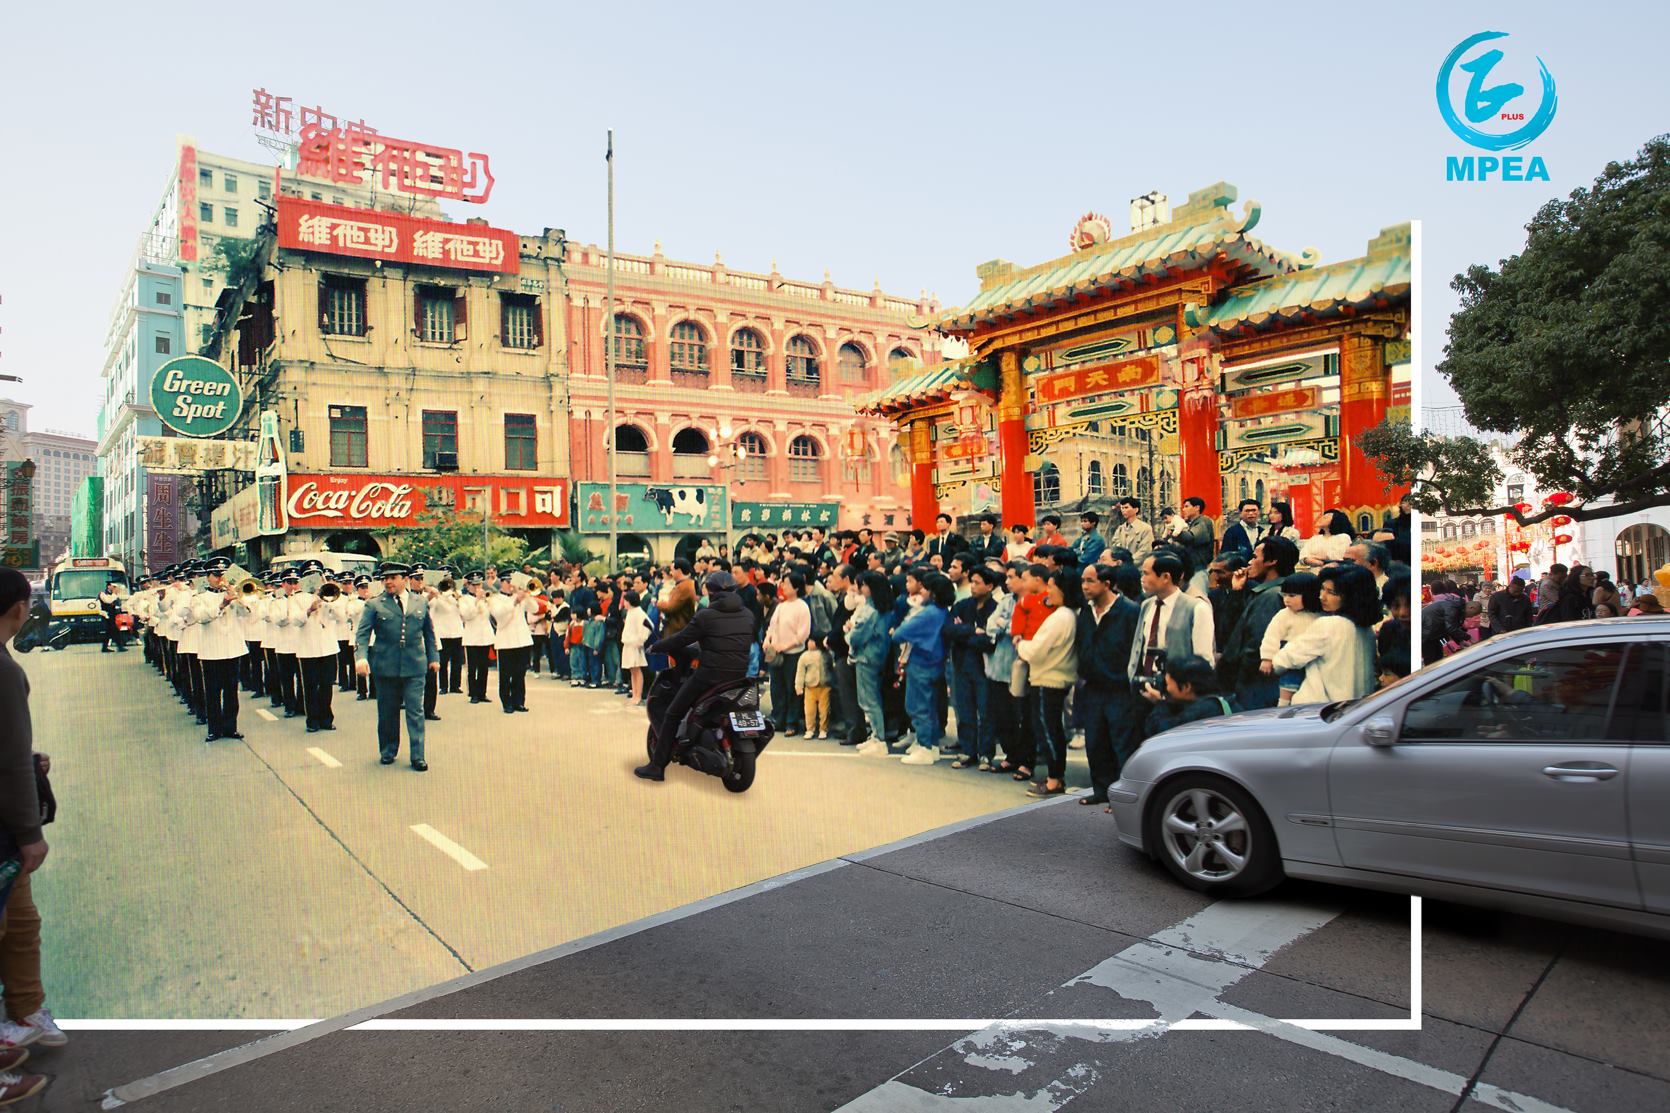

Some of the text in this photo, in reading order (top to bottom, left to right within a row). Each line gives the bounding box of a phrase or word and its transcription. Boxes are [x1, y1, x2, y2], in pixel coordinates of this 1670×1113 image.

[298, 214, 504, 265] 維他奶 維他奶
[163, 370, 231, 396] Green
[173, 395, 227, 424] Spot
[152, 482, 174, 554] 周生生
